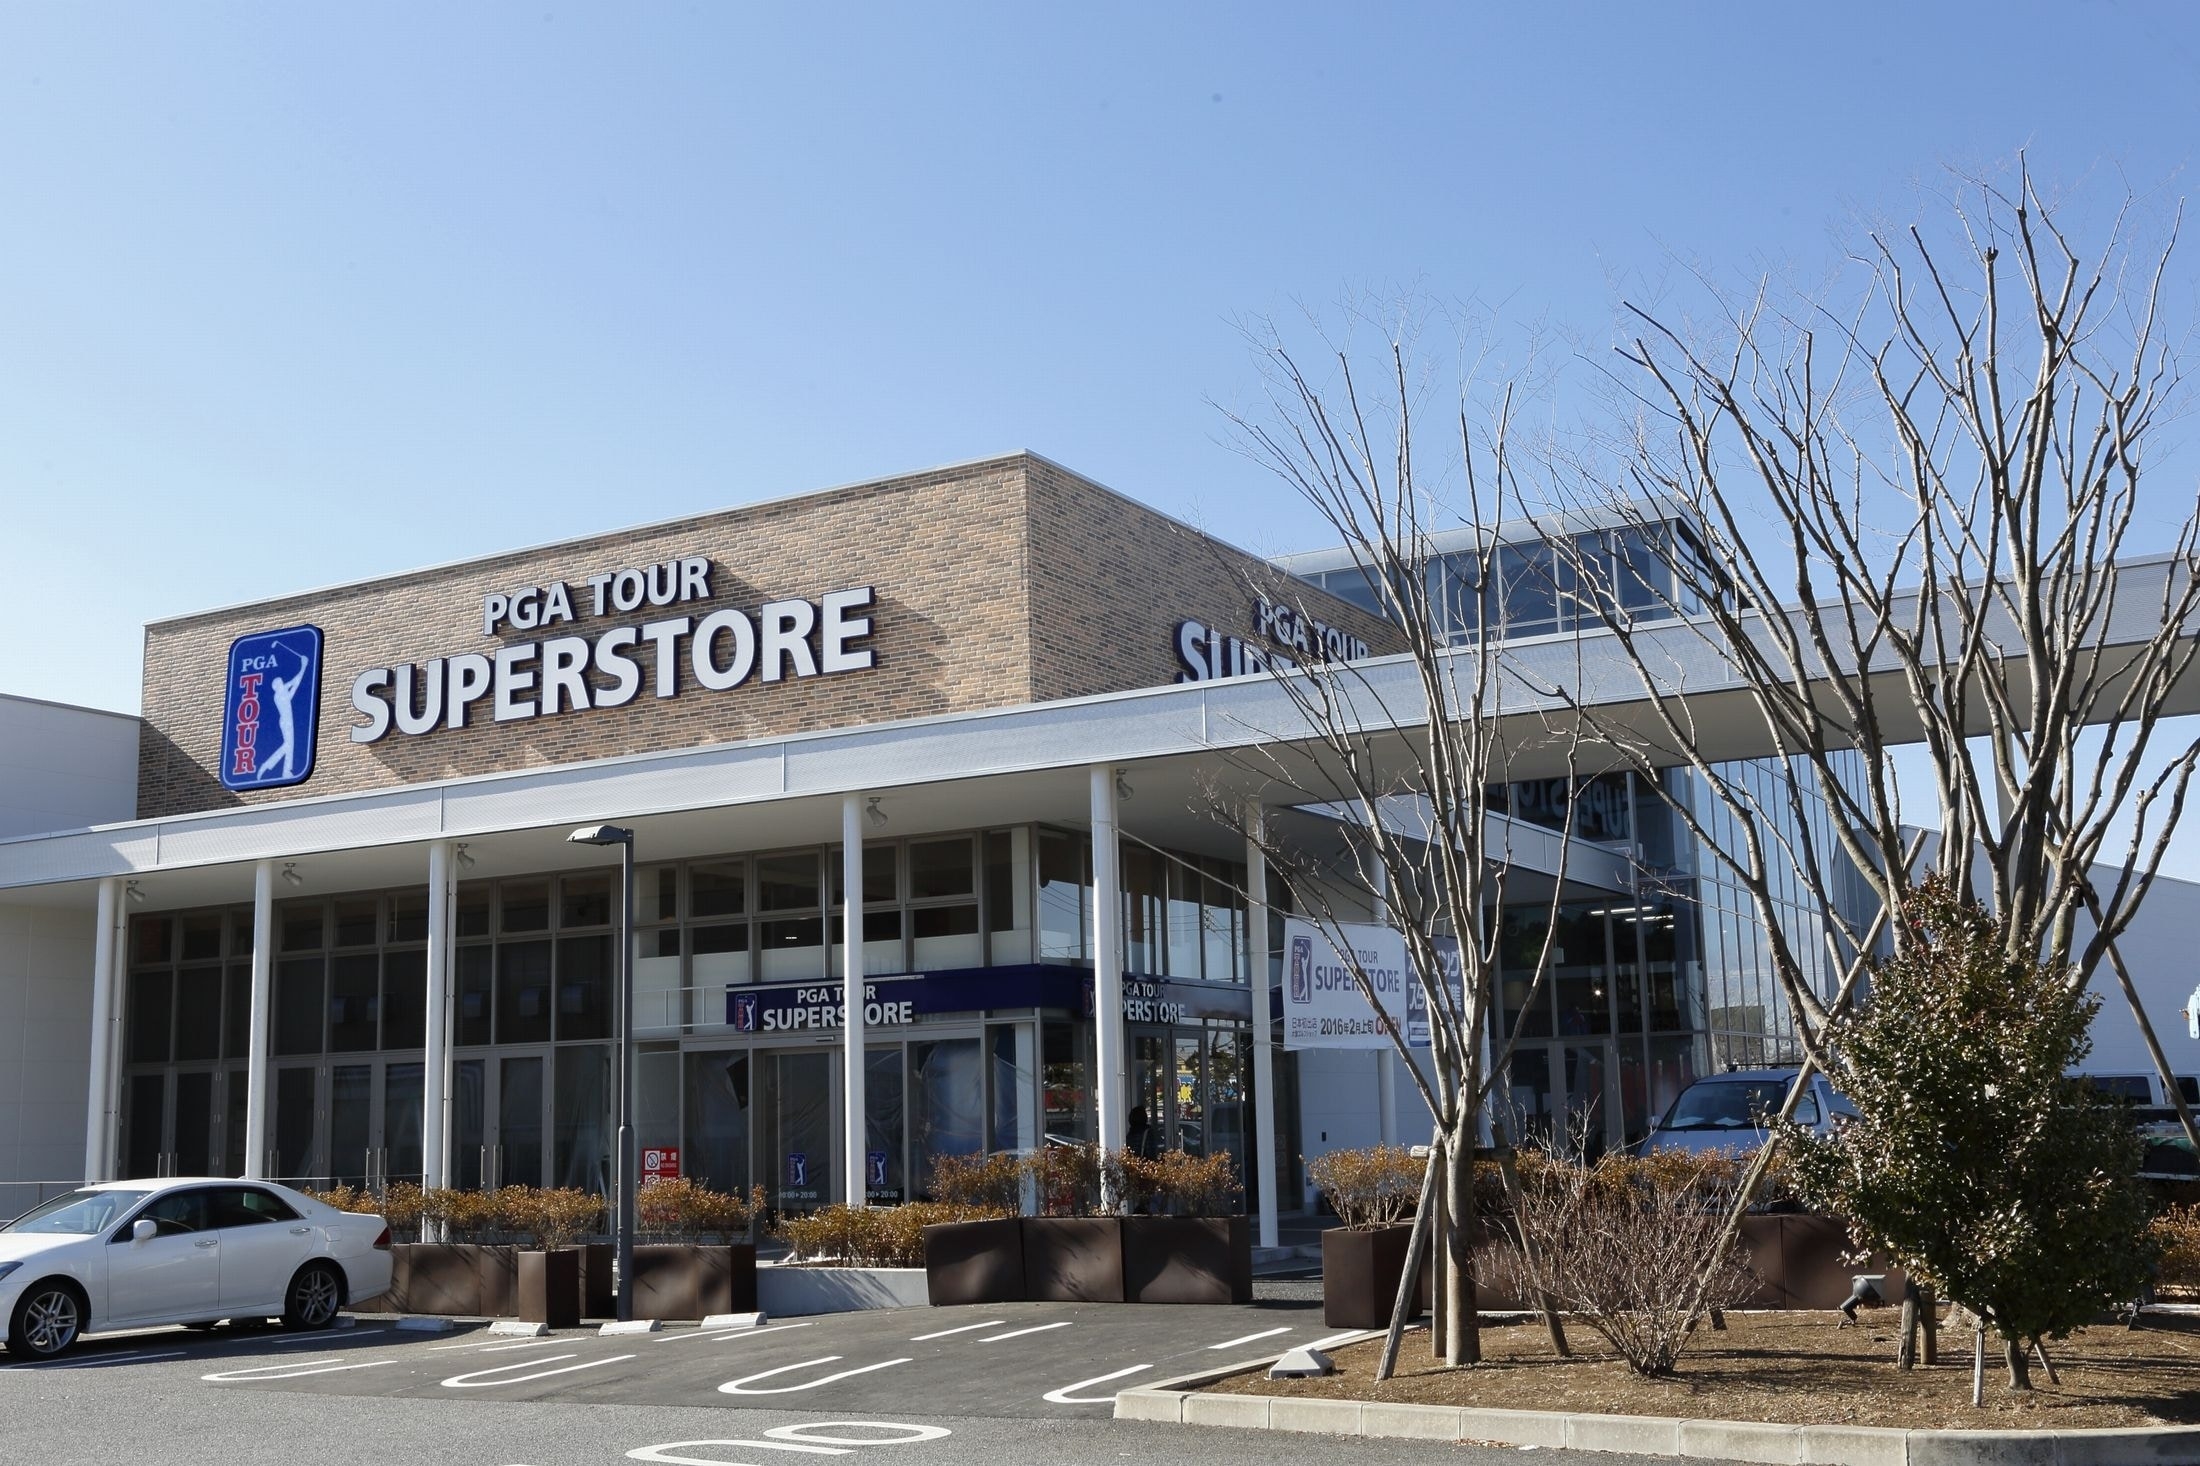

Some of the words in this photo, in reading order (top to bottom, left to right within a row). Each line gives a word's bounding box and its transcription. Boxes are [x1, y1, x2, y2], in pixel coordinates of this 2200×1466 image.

[483, 581, 575, 636] PGA
[587, 556, 713, 617] TOUR
[240, 654, 278, 673] PGA
[349, 586, 877, 744] SUPERSTORE
[233, 673, 263, 776] TOUR
[1358, 950, 1378, 963] TOUR
[1315, 966, 1399, 992] SUPETORE
[797, 988, 829, 1003] PGA
[834, 985, 876, 1001] TR
[763, 1001, 913, 1031] SUPERSORE
[880, 1190, 898, 1198] 20:00
